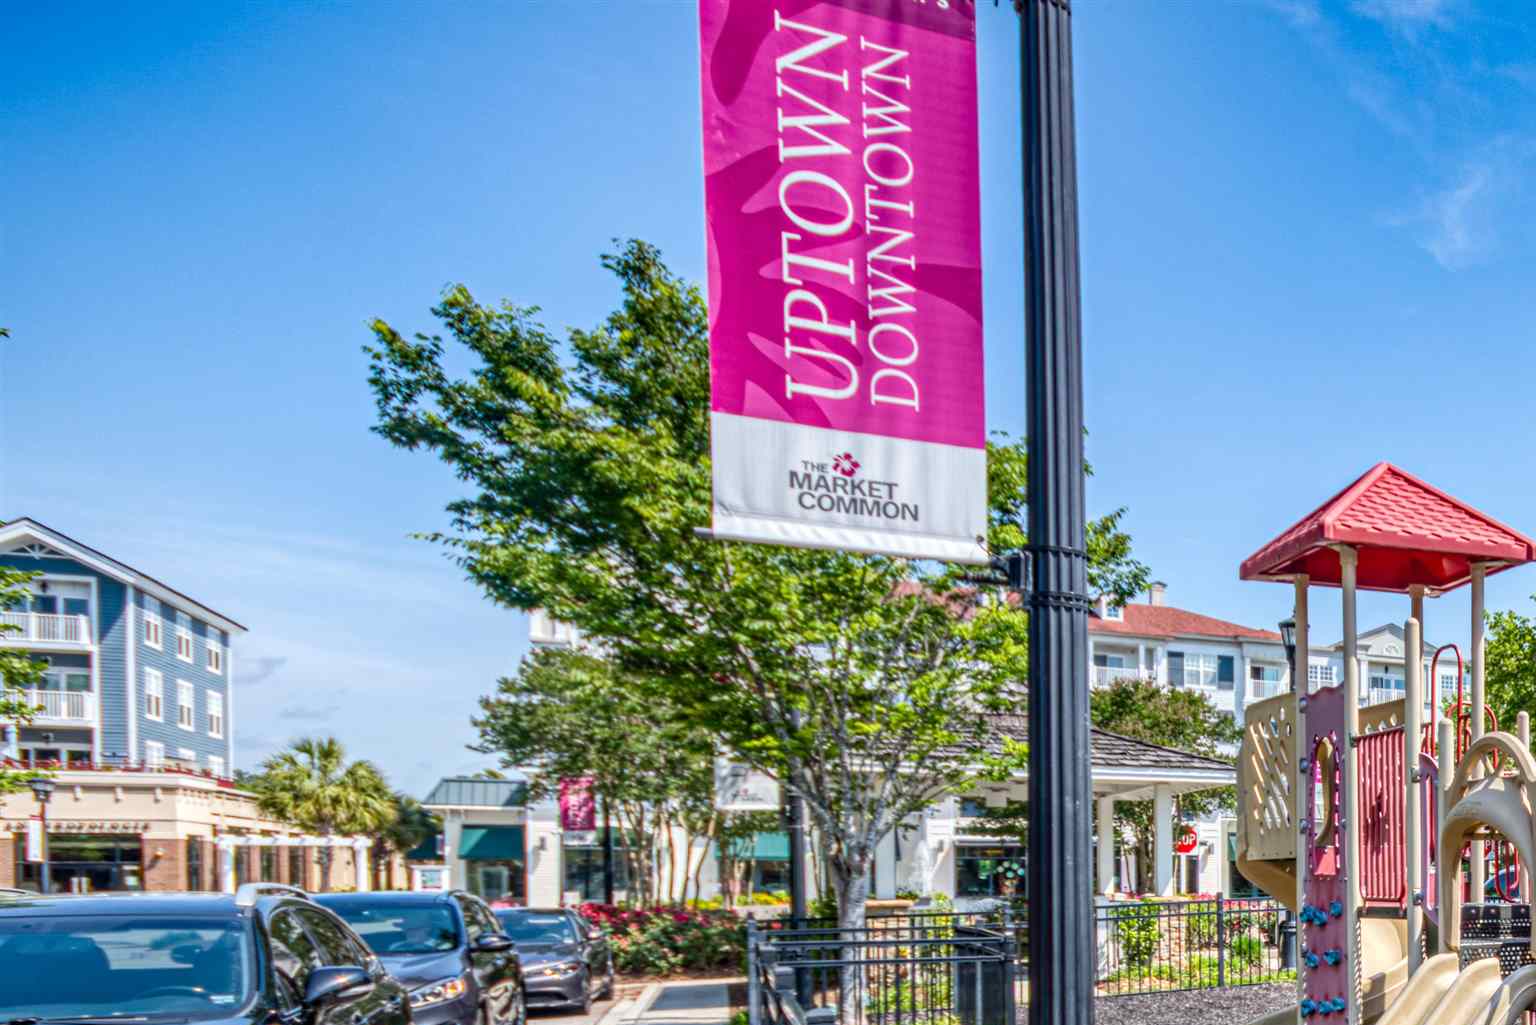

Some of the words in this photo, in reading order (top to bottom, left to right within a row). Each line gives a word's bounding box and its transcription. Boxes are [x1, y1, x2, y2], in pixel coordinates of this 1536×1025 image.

[774, 9, 861, 400] UPTOWN
[860, 35, 919, 412] DOWNTOWN
[801, 459, 829, 474] THE
[789, 469, 899, 500] MARKET
[798, 491, 919, 522] COMMON
